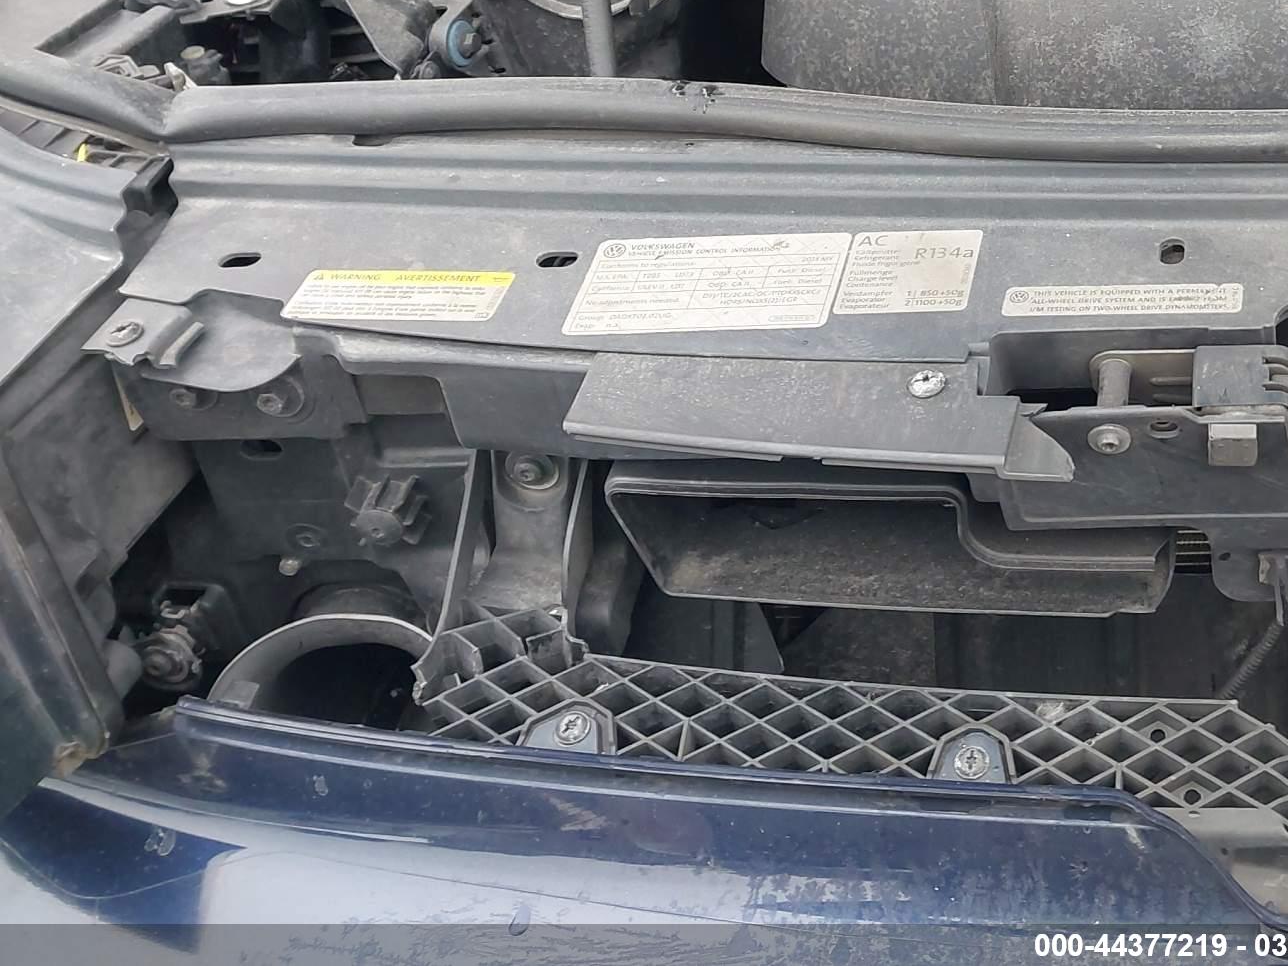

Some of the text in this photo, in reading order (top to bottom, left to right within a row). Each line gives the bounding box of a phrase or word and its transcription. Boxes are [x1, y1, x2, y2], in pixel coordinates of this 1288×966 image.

[858, 235, 888, 246] AC
[631, 242, 695, 251] VOLKSWAGEN
[914, 247, 974, 259] R134a
[395, 274, 480, 282] AVERTISSEMENT
